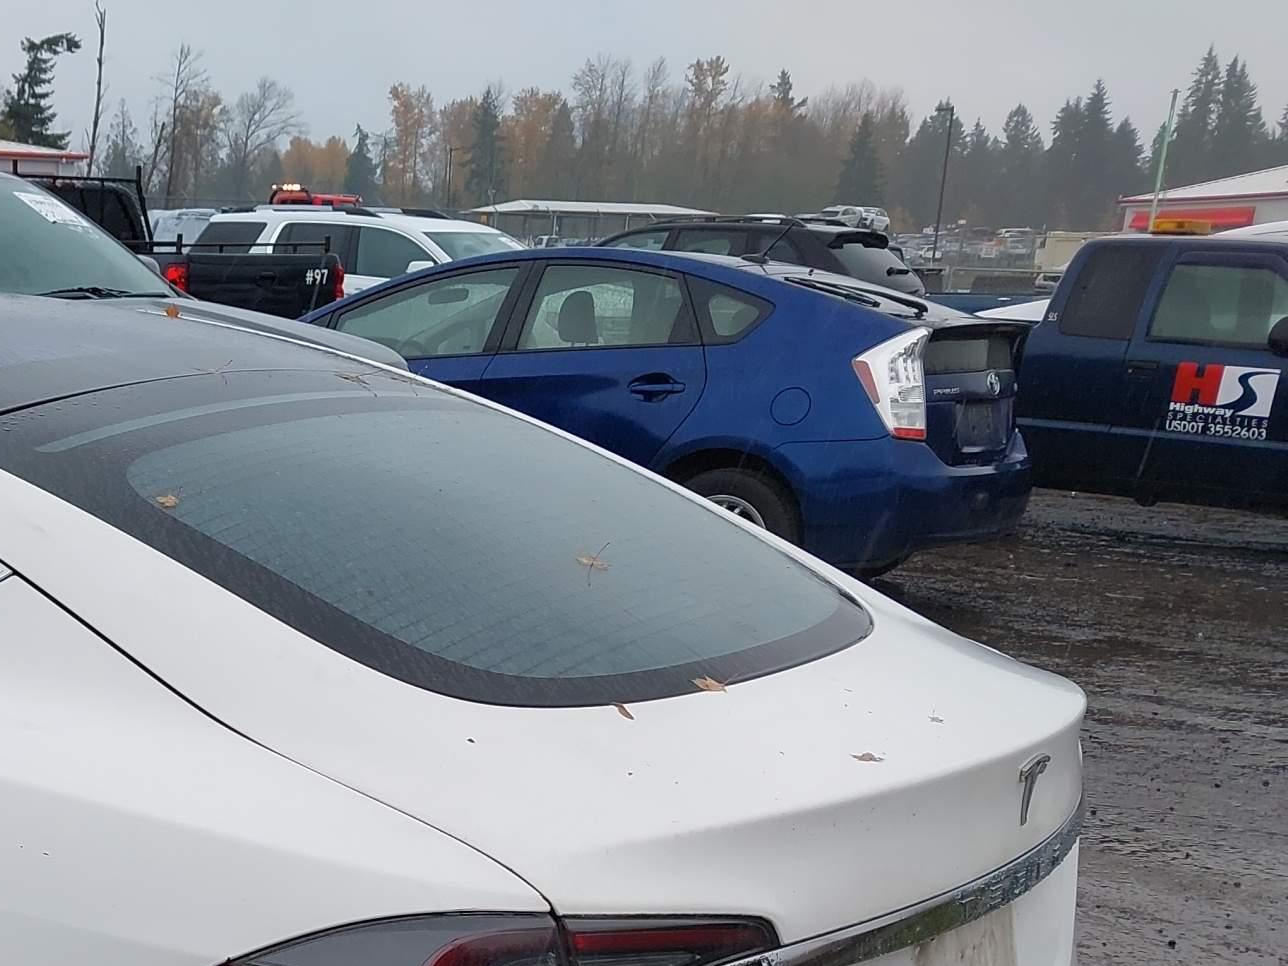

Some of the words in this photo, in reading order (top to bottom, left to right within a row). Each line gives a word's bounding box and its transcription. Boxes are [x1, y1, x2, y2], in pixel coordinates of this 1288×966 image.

[305, 268, 329, 285] #97
[1169, 402, 1235, 417] Highway
[1167, 411, 1269, 428] SPECIALTIES
[1165, 420, 1206, 434] USDOT
[1206, 423, 1267, 440] 3552603
